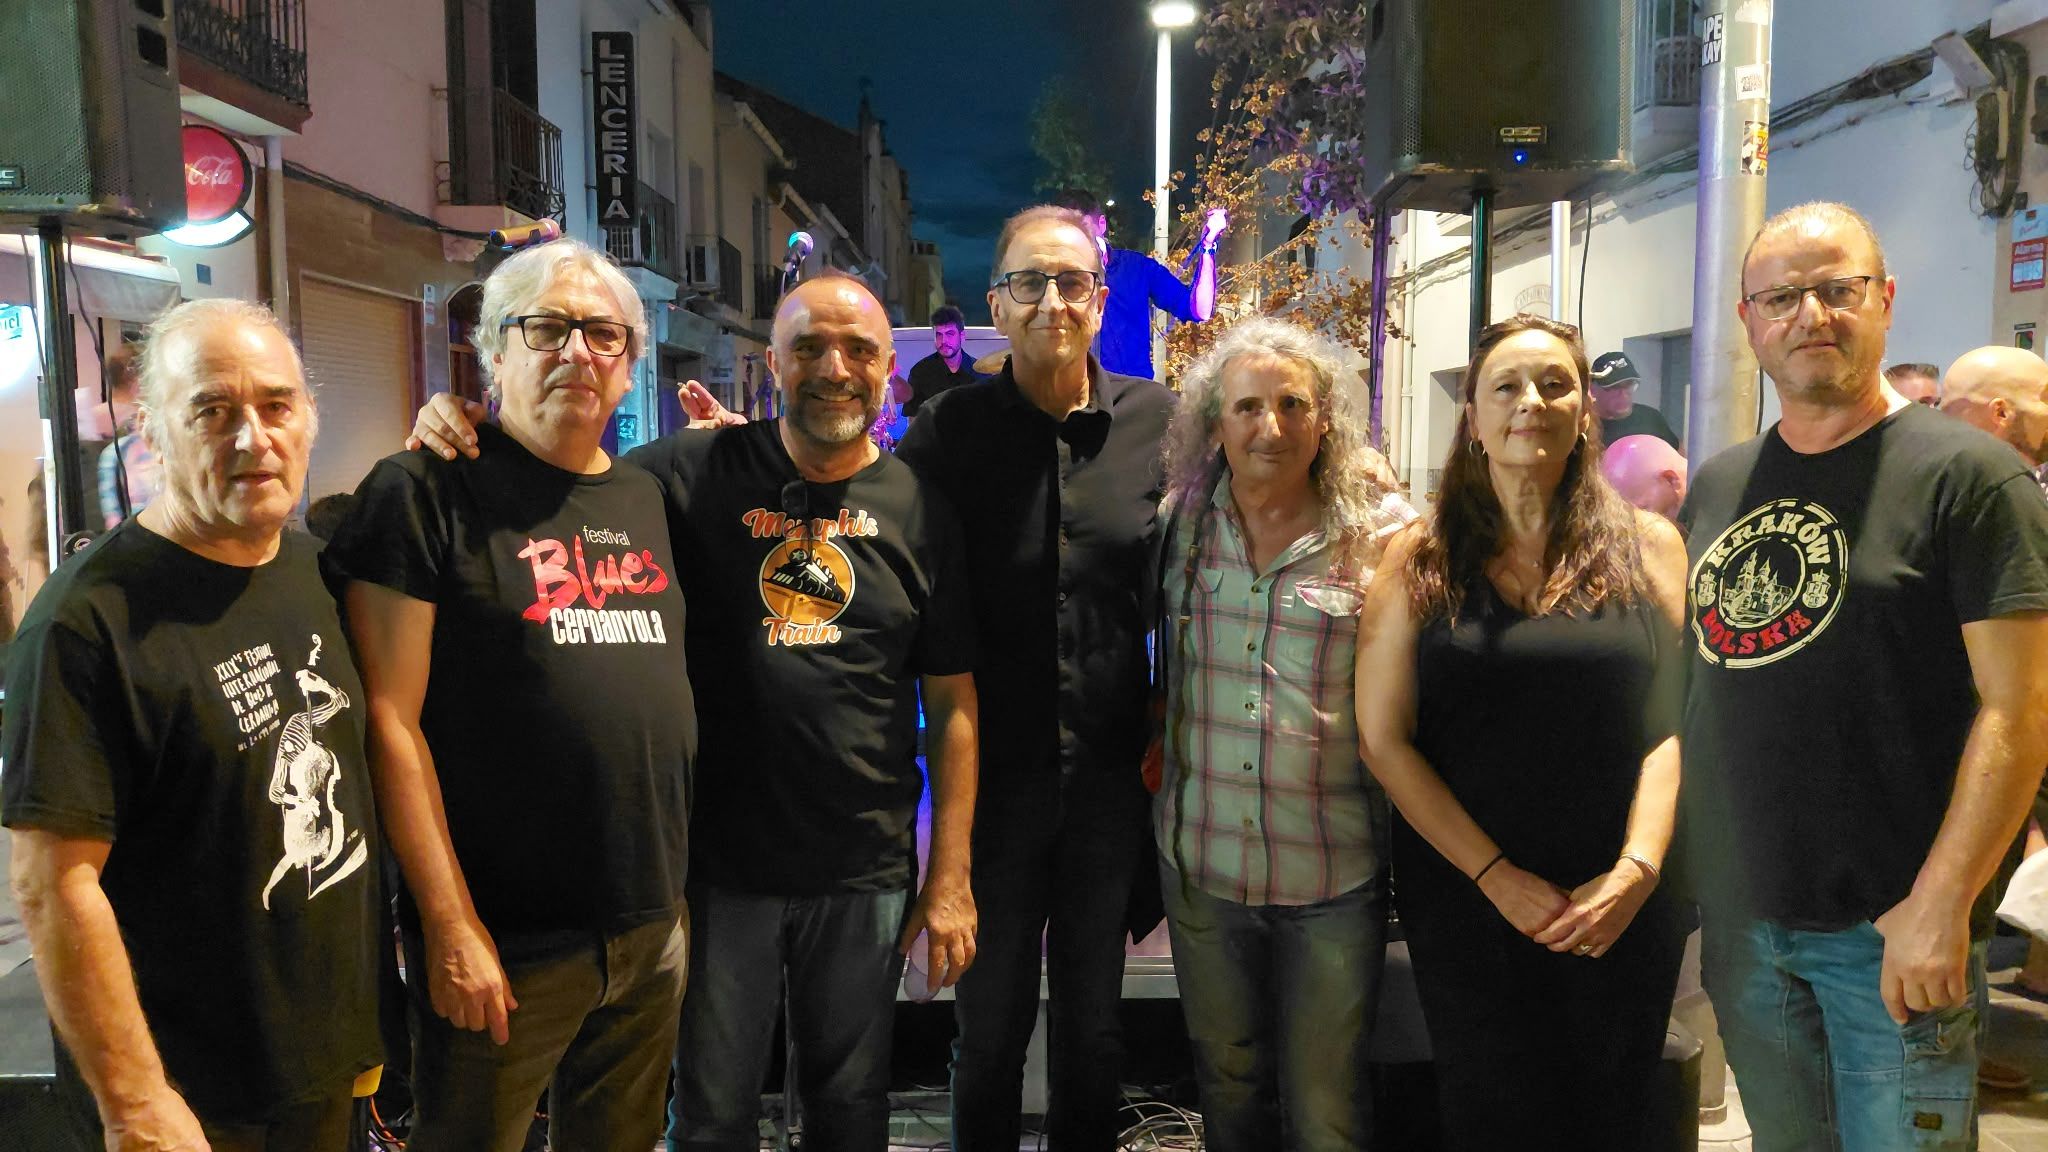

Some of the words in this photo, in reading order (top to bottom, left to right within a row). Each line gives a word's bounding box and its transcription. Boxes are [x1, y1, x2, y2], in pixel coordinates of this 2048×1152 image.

[599, 38, 631, 219] LENCERIA
[1500, 127, 1542, 136] QSC
[582, 526, 631, 546] festival
[517, 534, 669, 624] Blues
[763, 616, 841, 647] Train
[1702, 607, 1813, 655] POLSKA
[231, 700, 246, 716] DE
